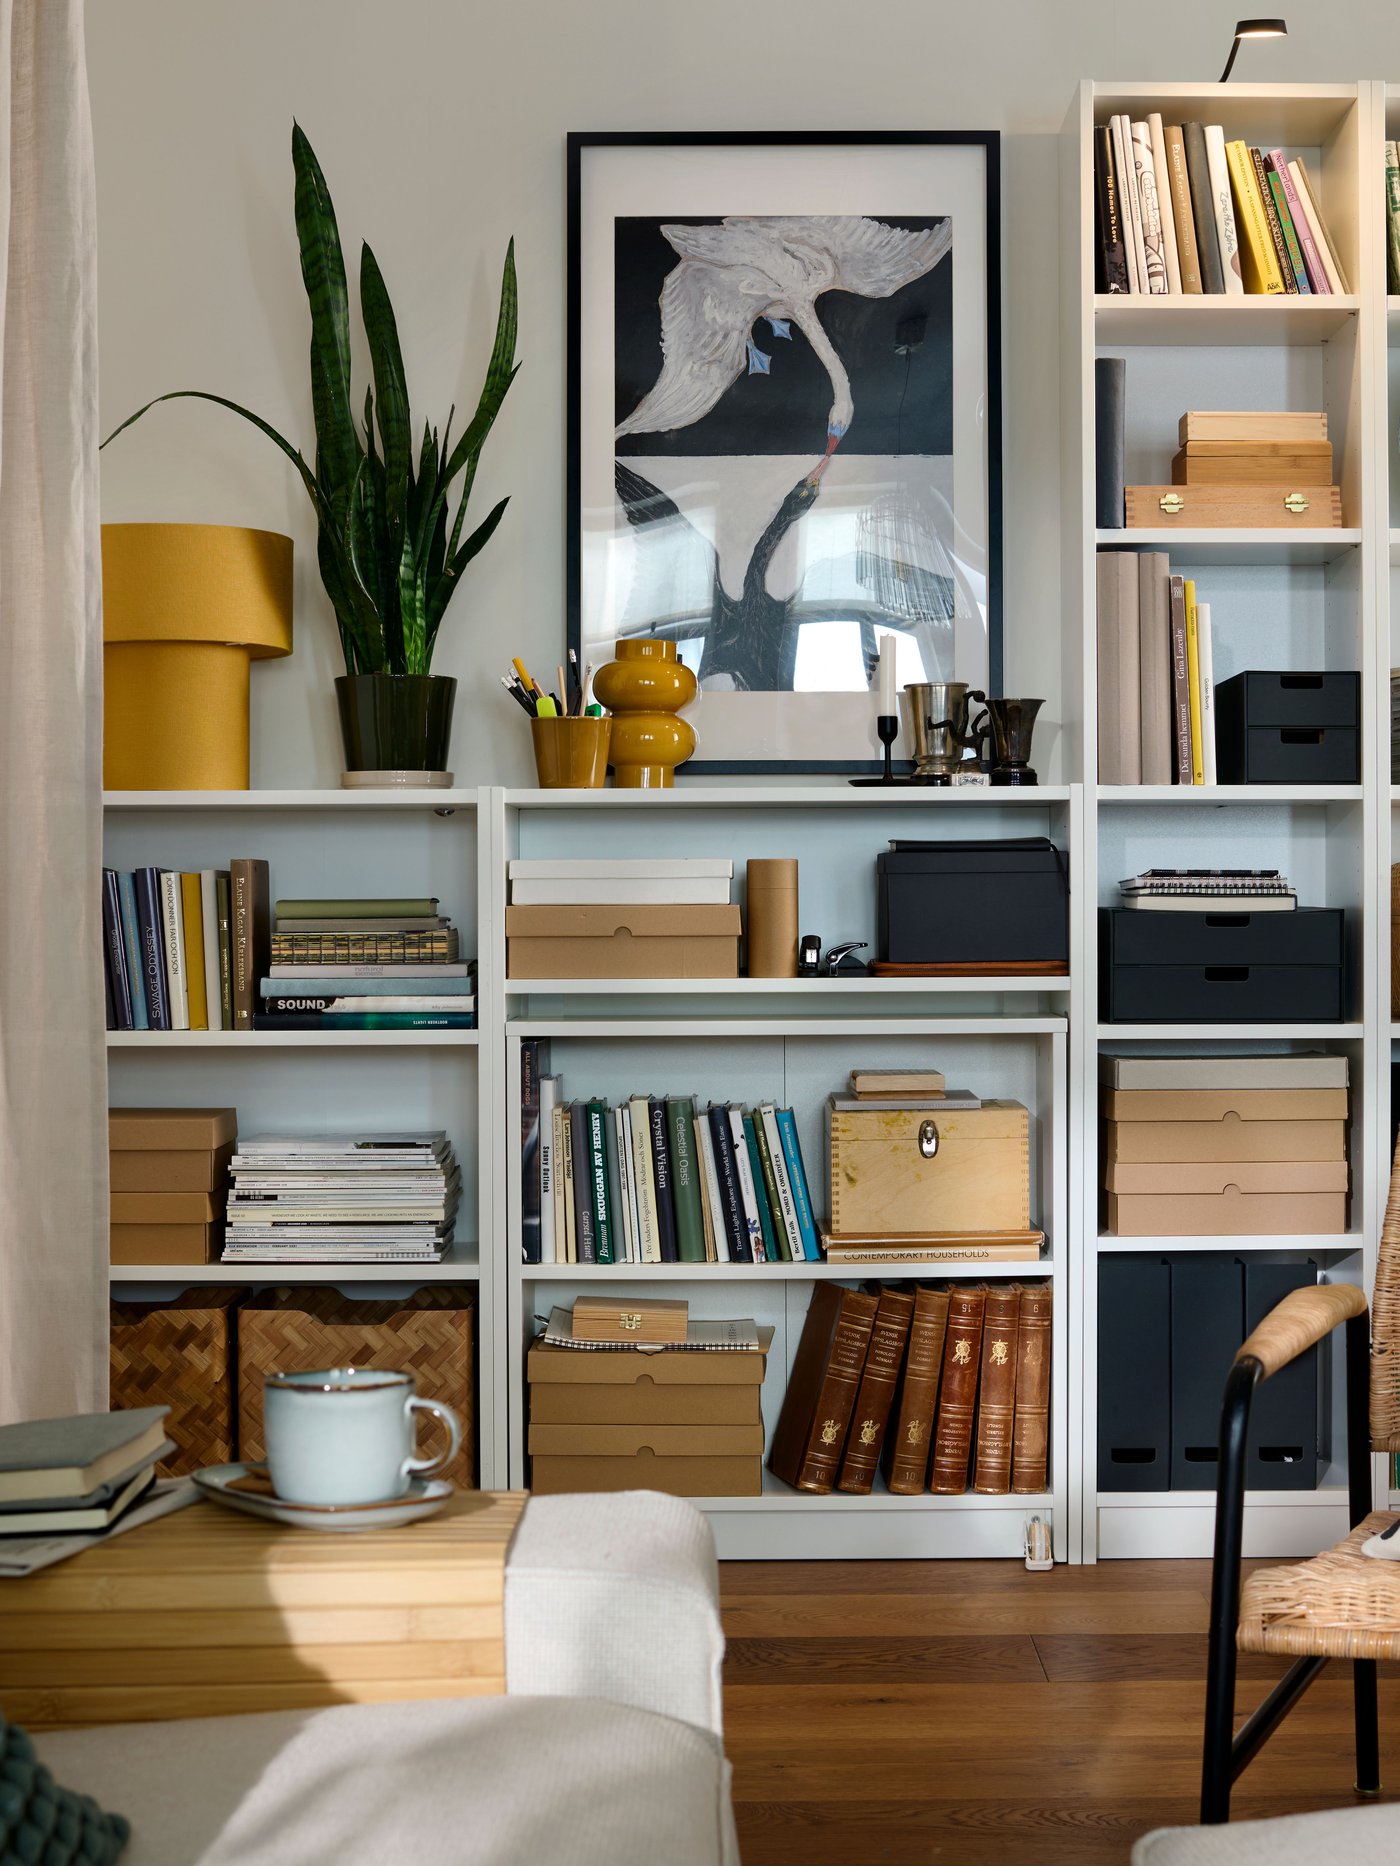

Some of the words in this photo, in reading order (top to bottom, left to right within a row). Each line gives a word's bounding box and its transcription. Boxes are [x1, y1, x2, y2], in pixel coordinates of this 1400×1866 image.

[1276, 154, 1295, 201] Netherlands
[1108, 189, 1116, 216] Homes
[1220, 192, 1230, 212] Zara
[1254, 154, 1273, 204] SLUTSTATION
[1266, 205, 1284, 250] BROOKLYN
[1223, 213, 1232, 227] the
[1224, 228, 1234, 253] Zebra
[1175, 628, 1185, 659] Lazenby
[1176, 660, 1184, 680] Gina
[1178, 704, 1188, 734] hemmet
[1181, 734, 1189, 759] sunda
[1181, 759, 1190, 774] Det
[236, 878, 244, 906] ELAINE
[168, 896, 176, 927] DONNER
[236, 908, 246, 935] KAGAN
[146, 926, 156, 975] ODYSSEY
[150, 978, 162, 1018] SAVAGE
[277, 999, 326, 1010] SOUND
[592, 1112, 602, 1150] HENRY
[653, 1110, 664, 1150] Crystal
[676, 1116, 687, 1159] Celestial
[542, 1145, 550, 1166] Sunny
[594, 1152, 602, 1166] AV
[724, 1156, 732, 1175] World
[542, 1167, 550, 1194] Outlook
[656, 1152, 666, 1189] Vision
[680, 1160, 689, 1186] Oasis
[594, 1168, 606, 1220] SKUGGAN
[729, 1188, 737, 1212] Explore
[783, 1196, 792, 1216] MORD
[582, 1211, 594, 1236] Cursed
[788, 1220, 796, 1235] Falk
[583, 1237, 592, 1258] Hunt
[734, 1234, 743, 1252] Travel
[792, 1235, 800, 1254] Bertil
[844, 1250, 924, 1260] CONTEMPORARY
[926, 1250, 990, 1258] HOUSEHOLDS
[961, 1304, 972, 1313] 15
[880, 1330, 898, 1338] SVENSK
[815, 1470, 826, 1480] 10
[905, 1471, 916, 1480] 10
